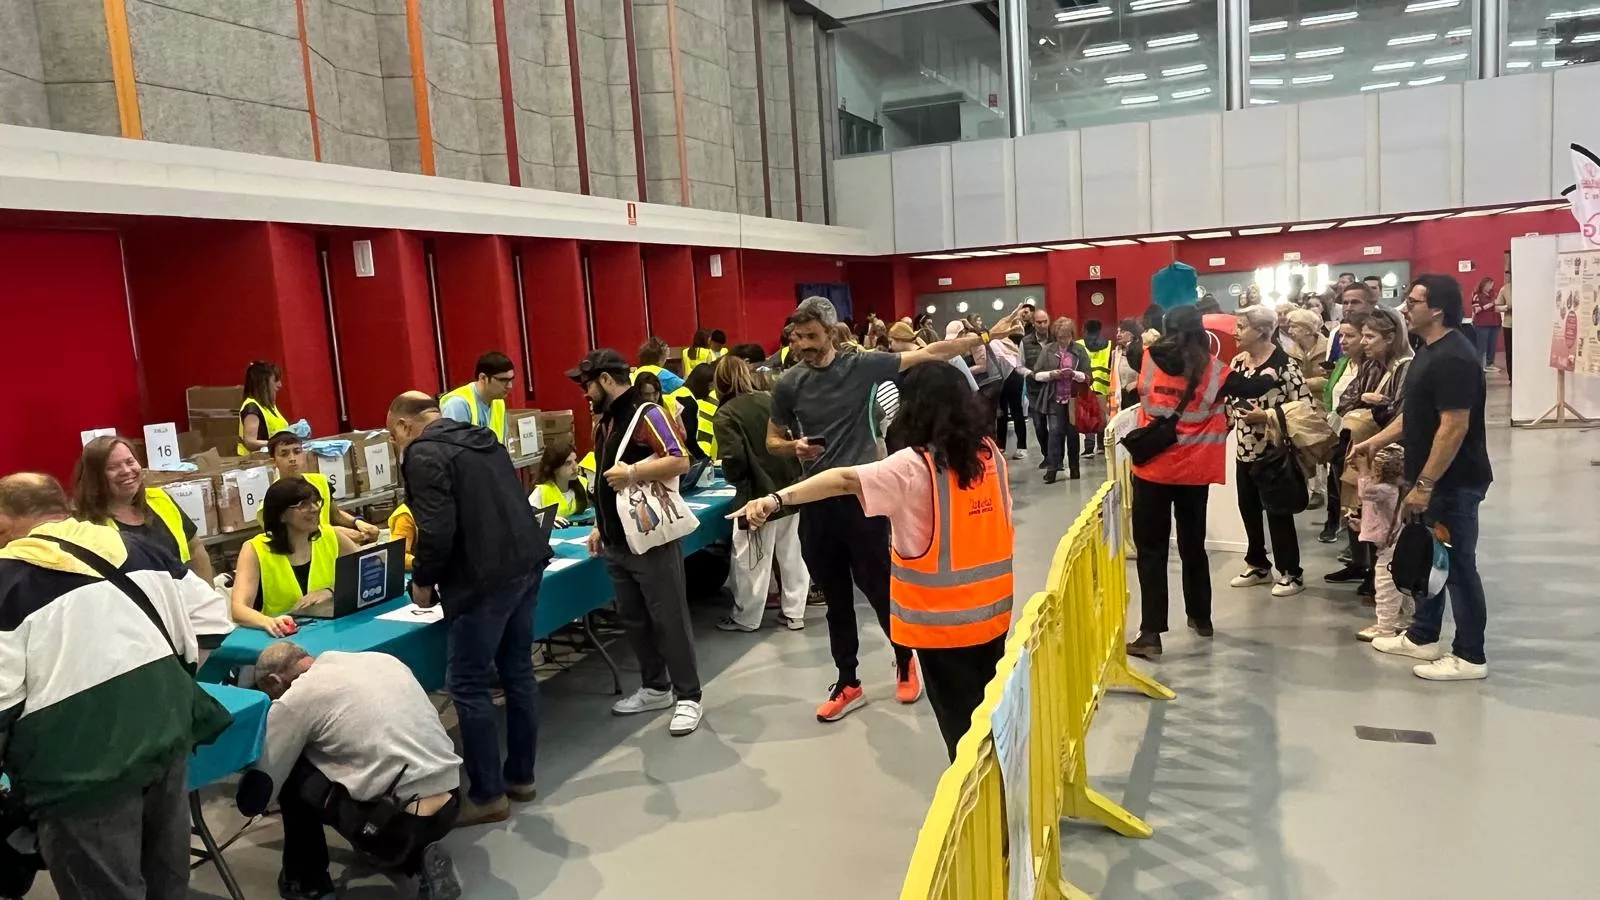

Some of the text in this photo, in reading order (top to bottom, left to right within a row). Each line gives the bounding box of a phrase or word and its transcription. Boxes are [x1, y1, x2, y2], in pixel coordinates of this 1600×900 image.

[158, 444, 172, 457] 16
[375, 464, 384, 476] M
[329, 474, 337, 486] S
[246, 493, 254, 506] 8
